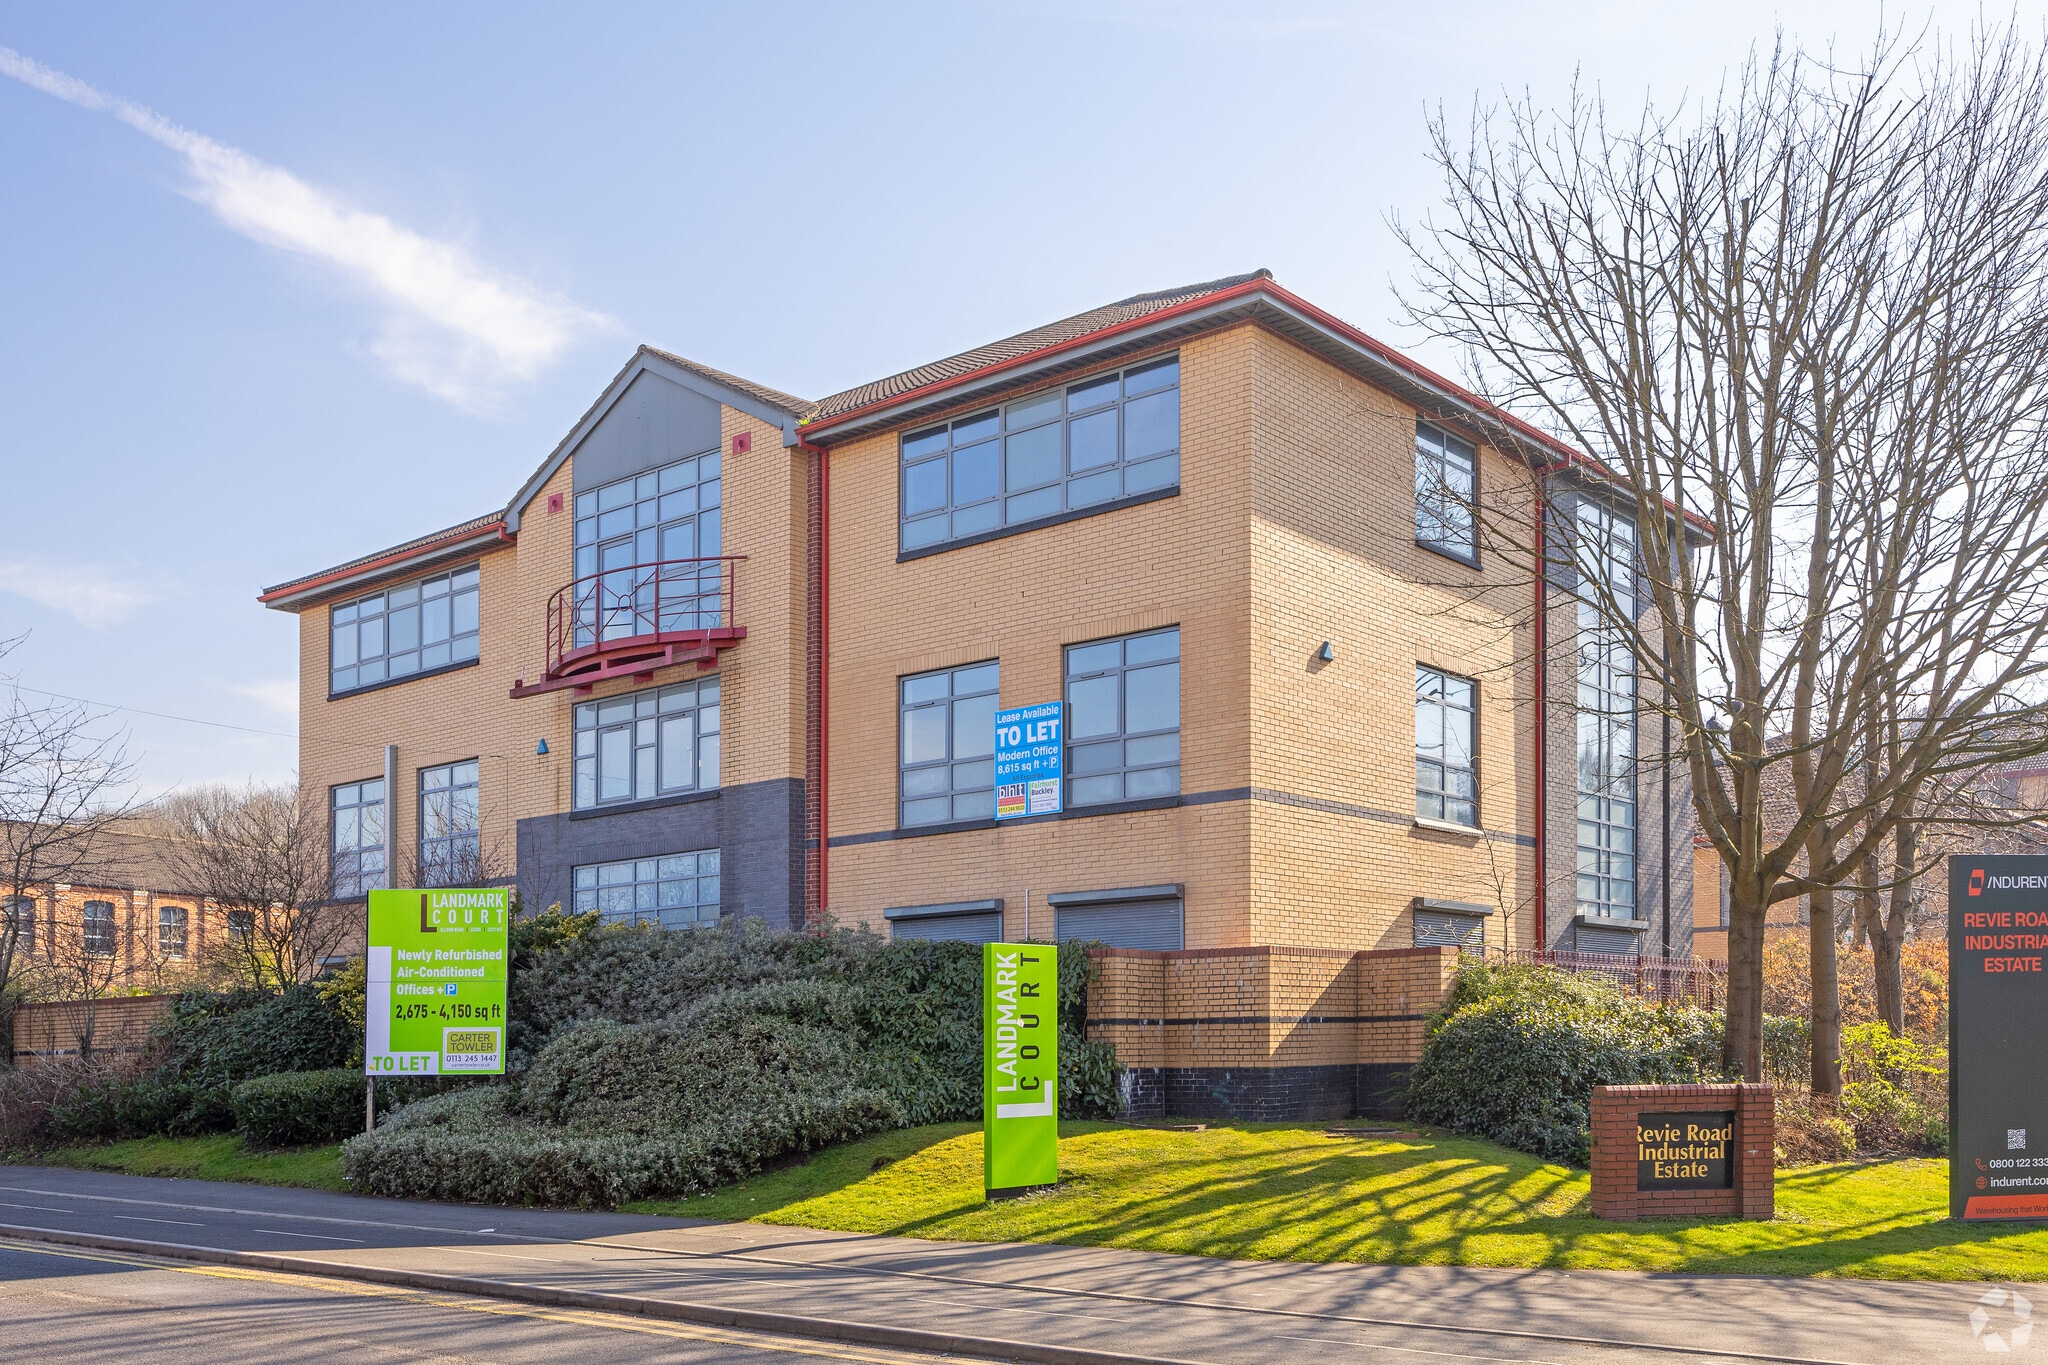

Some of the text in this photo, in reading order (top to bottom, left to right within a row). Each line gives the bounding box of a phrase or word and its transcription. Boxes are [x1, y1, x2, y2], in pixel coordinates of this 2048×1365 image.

[997, 705, 1058, 724] Lease Available
[997, 720, 1059, 747] TO LET
[998, 746, 1058, 762] Modern Office
[998, 763, 1019, 775] 8,615
[1022, 762, 1031, 771] sq
[1034, 760, 1039, 769] ft
[1032, 780, 1058, 788] Fairhurst
[433, 894, 504, 908] LANDMARK
[432, 910, 504, 924] COURT
[1964, 912, 2012, 928] REVIE
[398, 950, 502, 962] Newly Refurbished
[397, 966, 484, 977] Air-Conditioned
[1984, 957, 2042, 972] ESTATE
[396, 984, 434, 995] Offices
[396, 1004, 428, 1020] 2,675
[440, 1004, 471, 1020] 4,150
[474, 1006, 488, 1020] sq
[492, 1004, 500, 1018] ft
[997, 952, 1017, 1092] LANDMARK
[1020, 952, 1040, 1090] COURT
[450, 1034, 490, 1042] CARTER
[451, 1043, 493, 1051] TOWLER
[372, 1056, 430, 1071] TO LET
[1637, 1123, 1732, 1142] Revie Road
[1640, 1141, 1724, 1160] Industrial
[1654, 1162, 1708, 1178] Estate
[1990, 1160, 2014, 1168] 0800
[2016, 1159, 2030, 1167] 122
